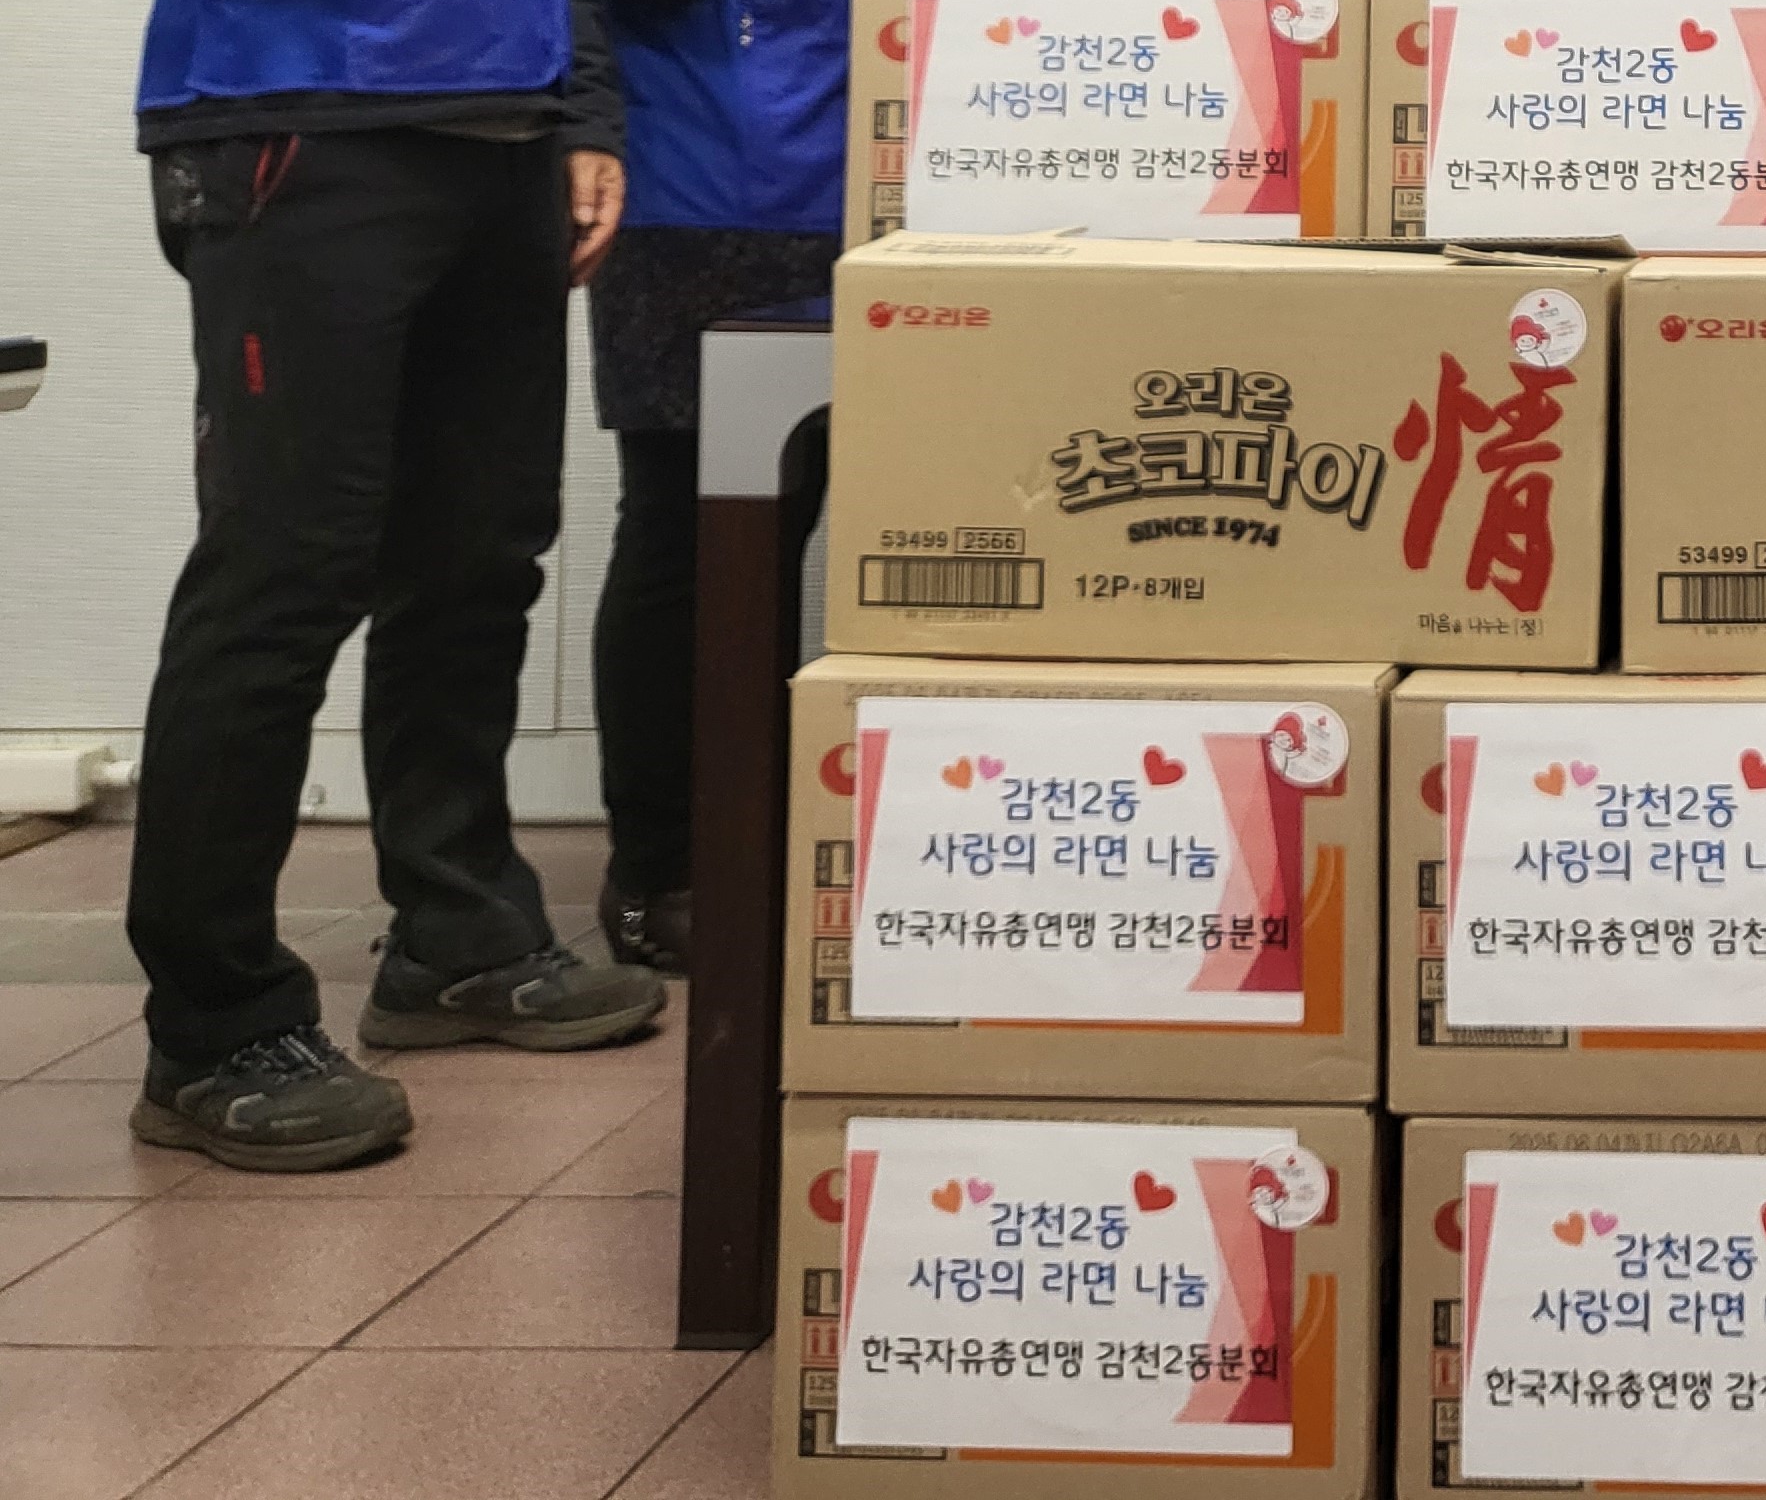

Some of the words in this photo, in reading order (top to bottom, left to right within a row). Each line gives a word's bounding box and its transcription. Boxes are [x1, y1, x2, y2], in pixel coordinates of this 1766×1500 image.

[1038, 34, 1160, 73] 감천2동
[1557, 46, 1678, 84] 감천2동
[968, 81, 1068, 118] 사랑의
[1084, 80, 1149, 118] 라면
[1165, 81, 1228, 118] 나눔
[1487, 93, 1587, 130] 사랑의
[1603, 93, 1667, 130] 라면
[1683, 93, 1747, 130] 나눔
[927, 148, 1120, 180] 한국자유총연맹
[1132, 147, 1289, 180] 감천2동분회
[1447, 159, 1639, 191] 한국자유총연맹
[903, 305, 992, 329] 오리온
[1133, 365, 1294, 421] 오리온
[1050, 424, 1389, 530] 초코파이
[1393, 351, 1578, 613] 情
[880, 530, 948, 548] 53499
[963, 531, 1017, 550] 2566
[1127, 515, 1207, 545] SINCE
[1212, 516, 1282, 548] 1974
[1679, 545, 1749, 564] 53499
[1000, 776, 1141, 823] 감천2동
[1596, 782, 1738, 828] 감천2동
[920, 832, 1036, 877] 사랑의
[1054, 833, 1128, 879] 라면
[1146, 834, 1219, 880] 나눔
[1514, 838, 1632, 883] 사랑의
[1650, 838, 1726, 883] 라면
[875, 909, 1096, 948] 한국자유총연맹
[1108, 911, 1289, 950] 감천2동분회
[1469, 917, 1694, 957] 한국자유총연맹
